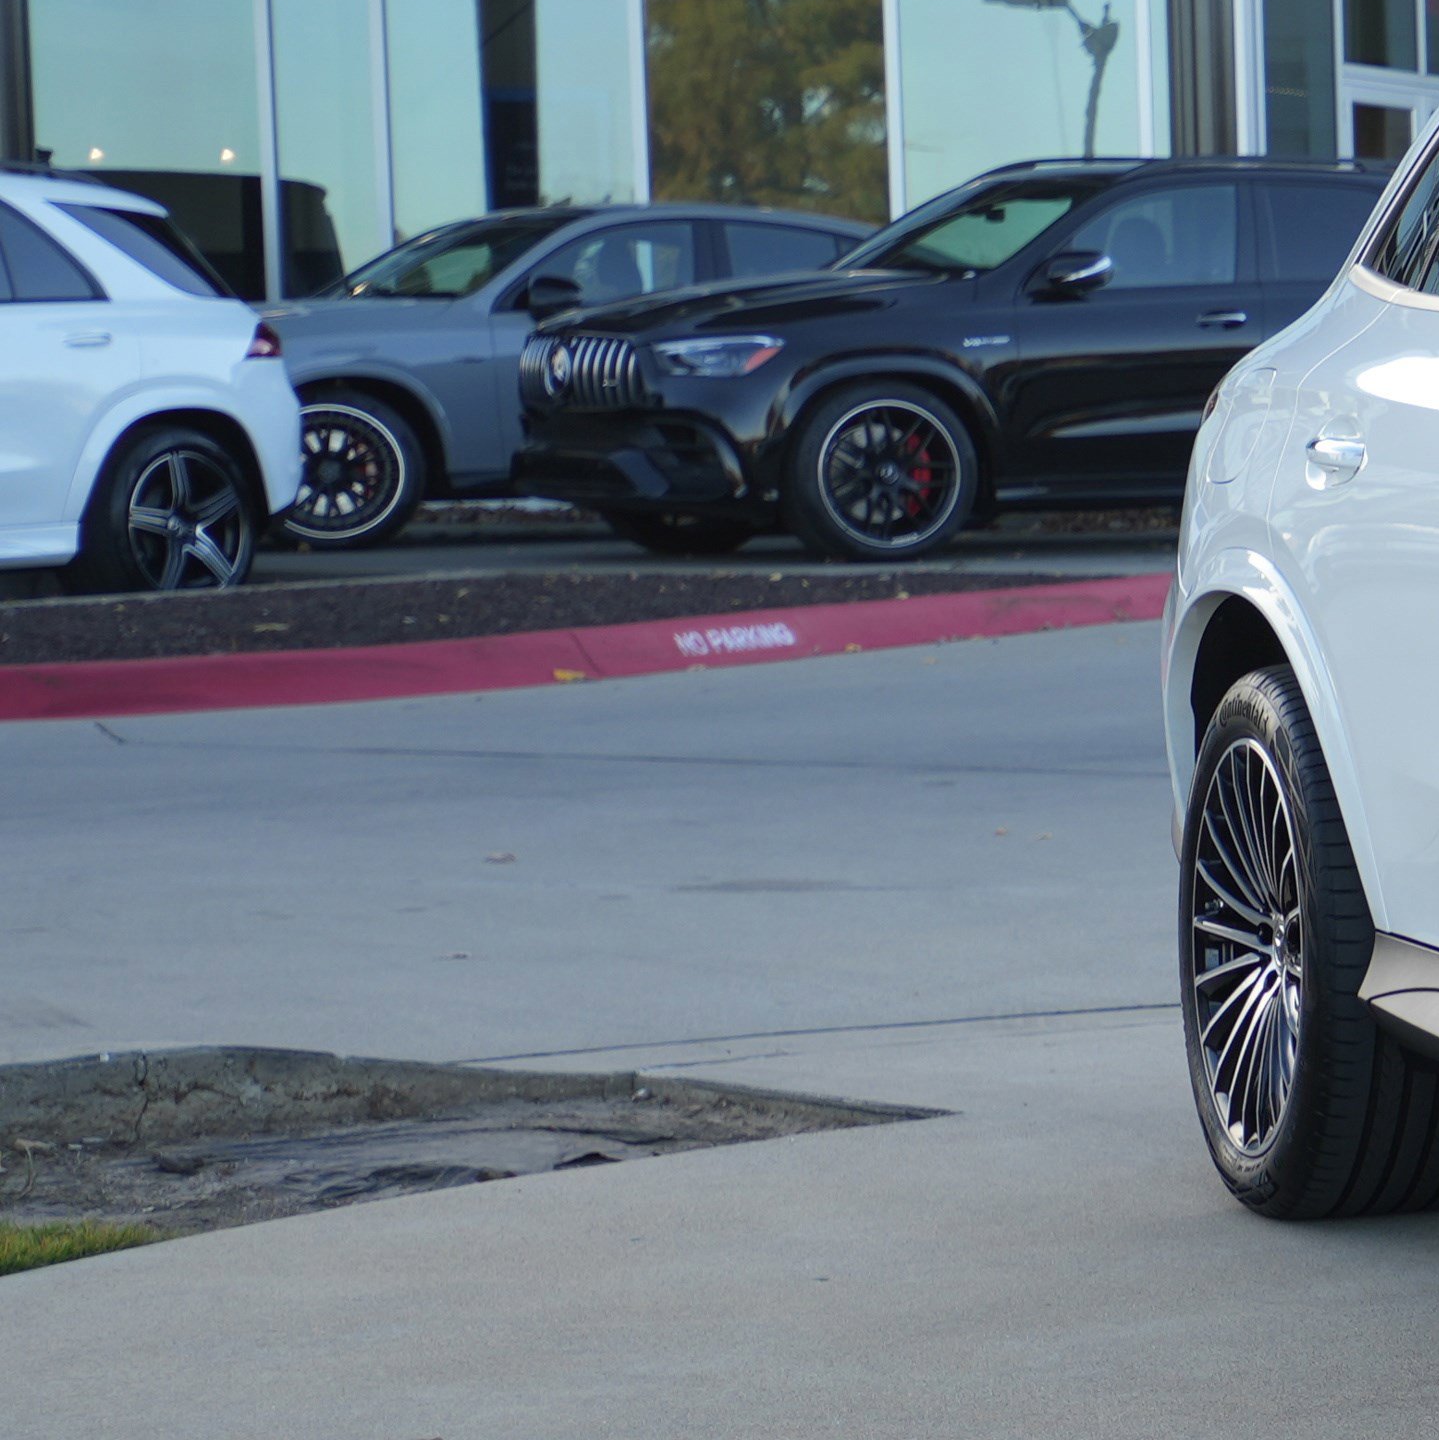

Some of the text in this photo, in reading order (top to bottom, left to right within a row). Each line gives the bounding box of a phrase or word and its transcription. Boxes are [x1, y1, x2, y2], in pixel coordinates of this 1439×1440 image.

[673, 622, 797, 657] NO PARKING
[1218, 693, 1263, 732] Continental
